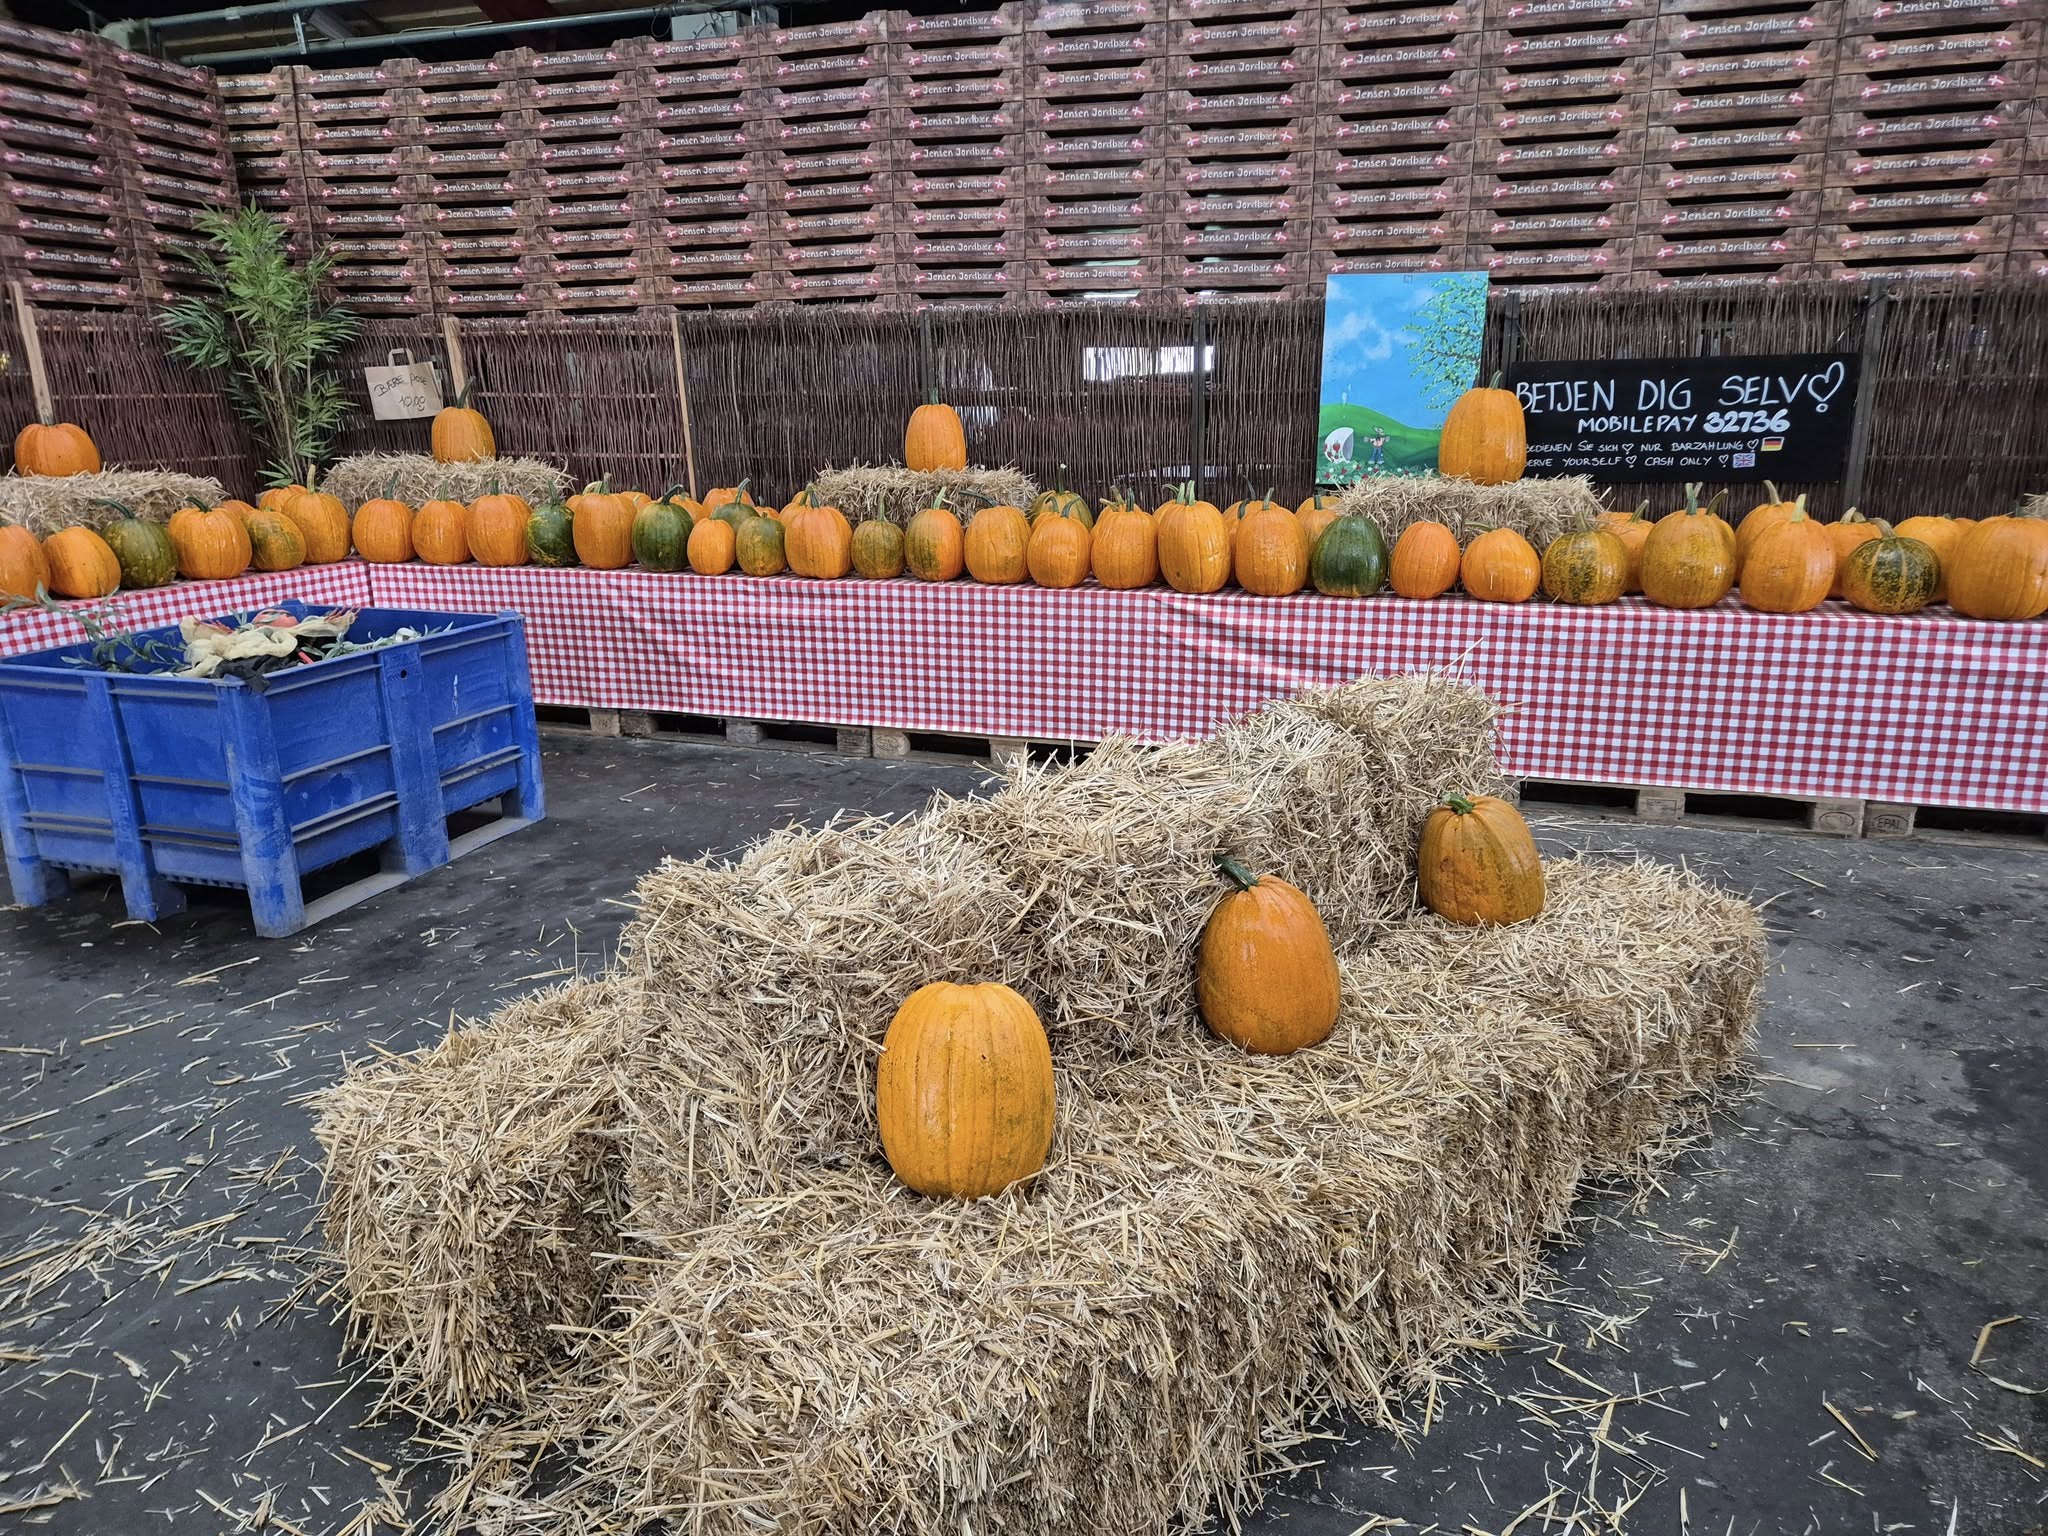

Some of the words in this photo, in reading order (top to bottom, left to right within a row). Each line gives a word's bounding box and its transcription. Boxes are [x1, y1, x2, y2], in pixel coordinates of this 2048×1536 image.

[1058, 9, 1091, 17] Jensen
[919, 19, 950, 28] Jensen
[1359, 18, 1396, 27] Jensen
[1700, 24, 1742, 35] Jensen
[787, 31, 817, 40] Jensen
[1204, 30, 1238, 39] Jensen
[1057, 42, 1090, 51] Jensen
[1521, 40, 1561, 50] Jensen
[1888, 41, 1934, 54] Jensen
[922, 54, 952, 62] Jensen
[1356, 53, 1393, 63] Jensen
[1201, 64, 1236, 74] Jensen
[1697, 62, 1739, 72] Jensen
[667, 75, 695, 83] Jensen
[1057, 74, 1090, 83] Jensen
[1520, 78, 1559, 87] Jensen
[922, 85, 953, 94] Jensen
[1881, 82, 1927, 93] Jensen
[1354, 89, 1390, 99] Jensen
[1200, 98, 1235, 108] Jensen
[1691, 98, 1733, 108] Jensen
[1057, 109, 1089, 118] Jensen
[550, 118, 577, 127] Jensen
[921, 116, 952, 126] Jensen
[1517, 114, 1556, 123] Jensen
[1352, 123, 1388, 133] Jensen
[1877, 122, 1922, 132] Jensen
[1201, 134, 1235, 143] Jensen
[1689, 136, 1731, 146] Jensen
[1057, 141, 1089, 150] Jensen
[923, 148, 953, 158] Jensen
[1514, 149, 1553, 159] Jensen
[1352, 158, 1387, 168] Jensen
[1872, 160, 1917, 169] Jensen
[1059, 171, 1090, 181] Jensen
[1201, 169, 1234, 178] Jensen
[1685, 175, 1726, 184] Jensen
[925, 181, 955, 189] Jensen
[1510, 184, 1548, 194] Jensen
[675, 196, 702, 204] Jensen
[1351, 194, 1386, 202] Jensen
[1200, 201, 1233, 210] Jensen
[1867, 198, 1912, 210] Jensen
[1057, 205, 1089, 214] Jensen
[926, 212, 955, 220] Jensen
[1680, 209, 1721, 220] Jensen
[798, 219, 826, 227] Jensen
[1508, 220, 1546, 229] Jensen
[1349, 228, 1384, 236] Jensen
[1198, 232, 1231, 242] Jensen
[1862, 235, 1905, 245] Jensen
[1058, 238, 1090, 246] Jensen
[926, 243, 955, 252] Jensen
[1675, 245, 1716, 256] Jensen
[1505, 255, 1543, 264] Jensen
[566, 262, 592, 270] Jensen
[1197, 264, 1230, 273] Jensen
[1347, 261, 1382, 269] Jensen
[927, 272, 956, 280] Jensen
[1059, 270, 1090, 278] Jensen
[683, 284, 710, 292] Jensen
[1516, 379, 1615, 413] BETJEN
[1637, 378, 1692, 411] DIG
[1718, 374, 1808, 406] SELV
[1577, 414, 1698, 434] MOBILEPAY
[1703, 408, 1791, 433] 32736
[1597, 443, 1618, 452] SICH
[1640, 443, 1663, 452] NUR
[1671, 441, 1744, 452] BARZAHLUNG
[1562, 457, 1622, 467] YOURSELF
[1644, 456, 1674, 467] CASH
[1680, 456, 1712, 467] ONLY
[1877, 817, 1903, 830] EPAL
